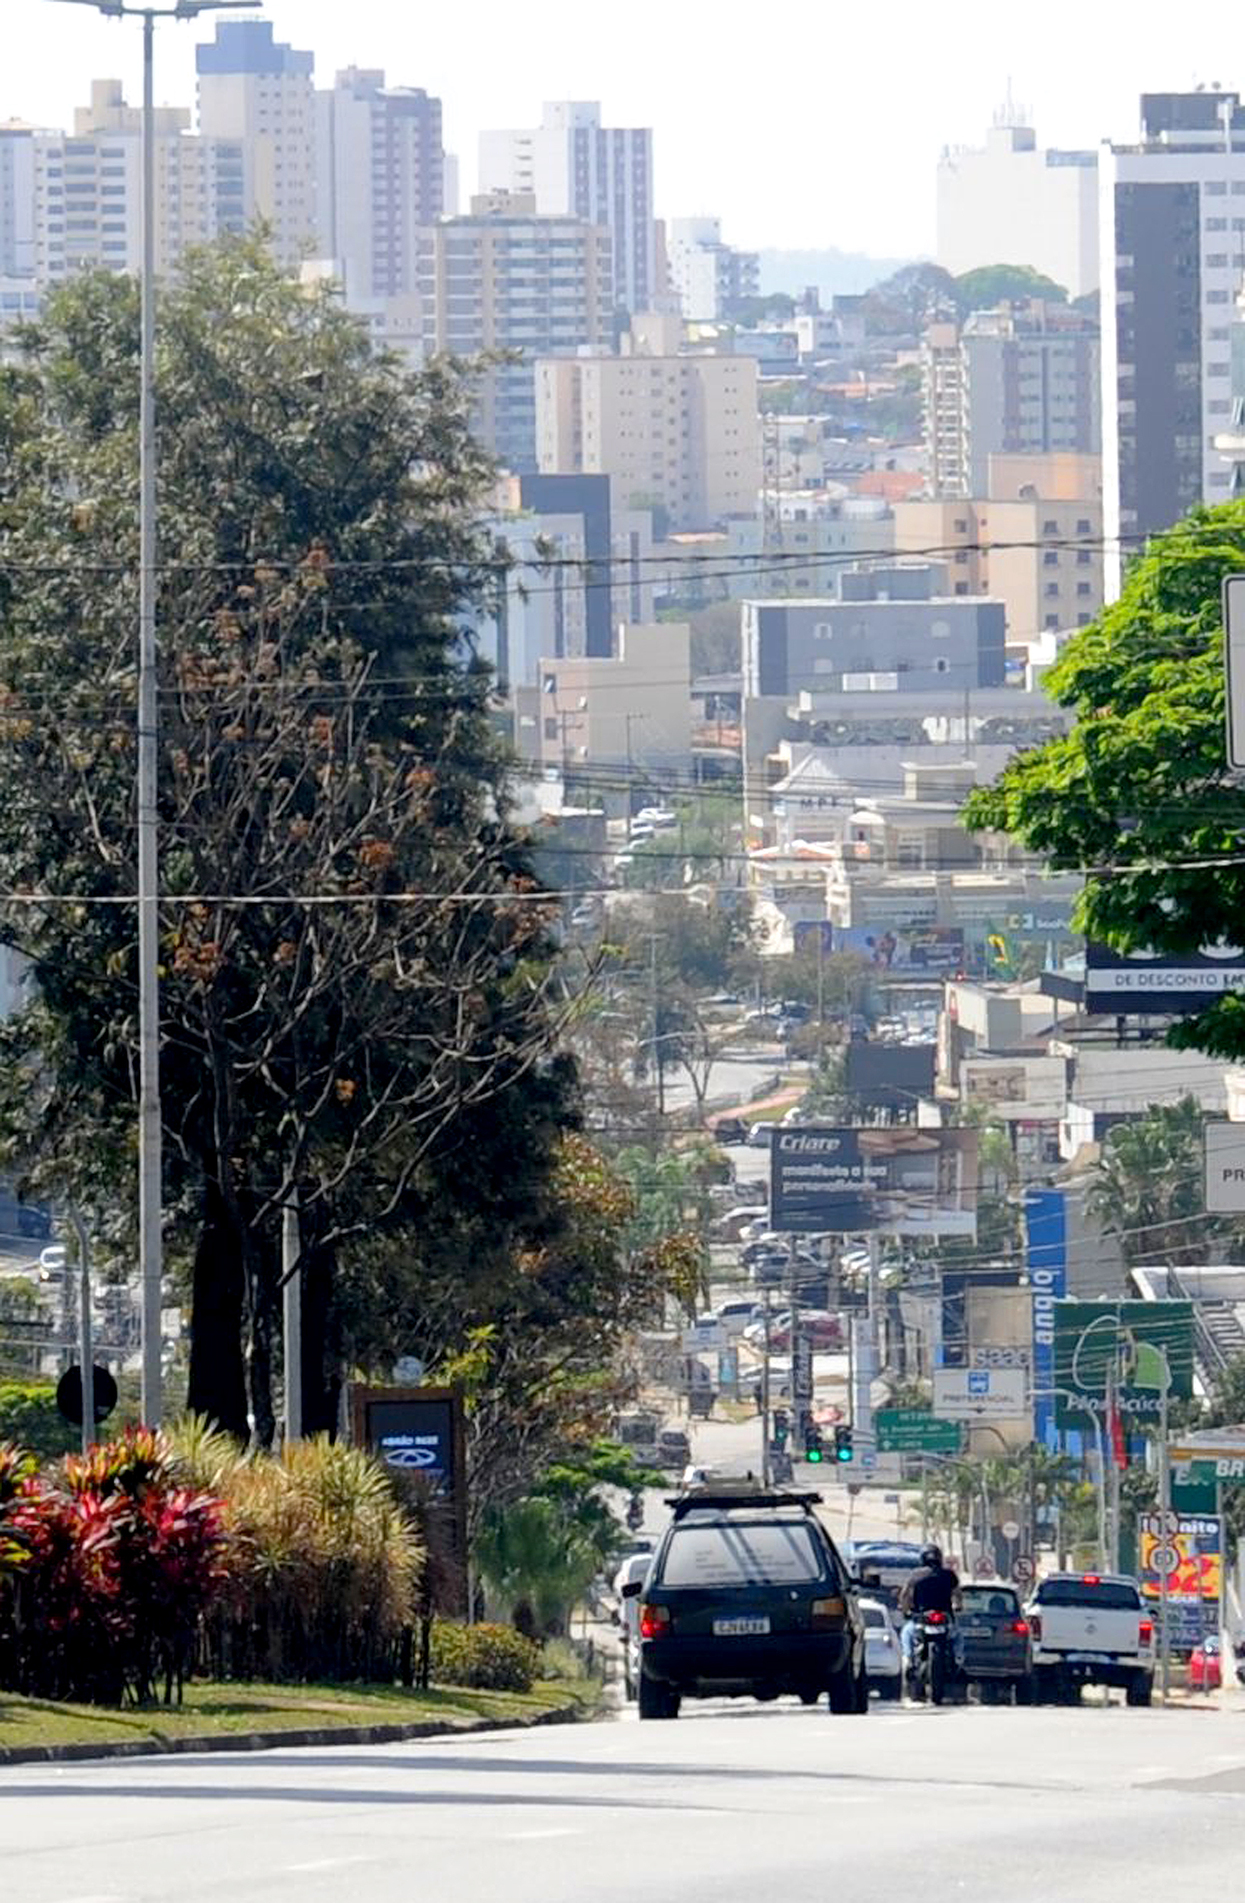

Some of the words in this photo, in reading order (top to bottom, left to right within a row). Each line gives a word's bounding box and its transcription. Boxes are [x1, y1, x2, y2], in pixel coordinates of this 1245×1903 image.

[1115, 974, 1132, 986] DE
[1138, 974, 1218, 986] DESCONTO
[780, 1134, 840, 1152] Criare
